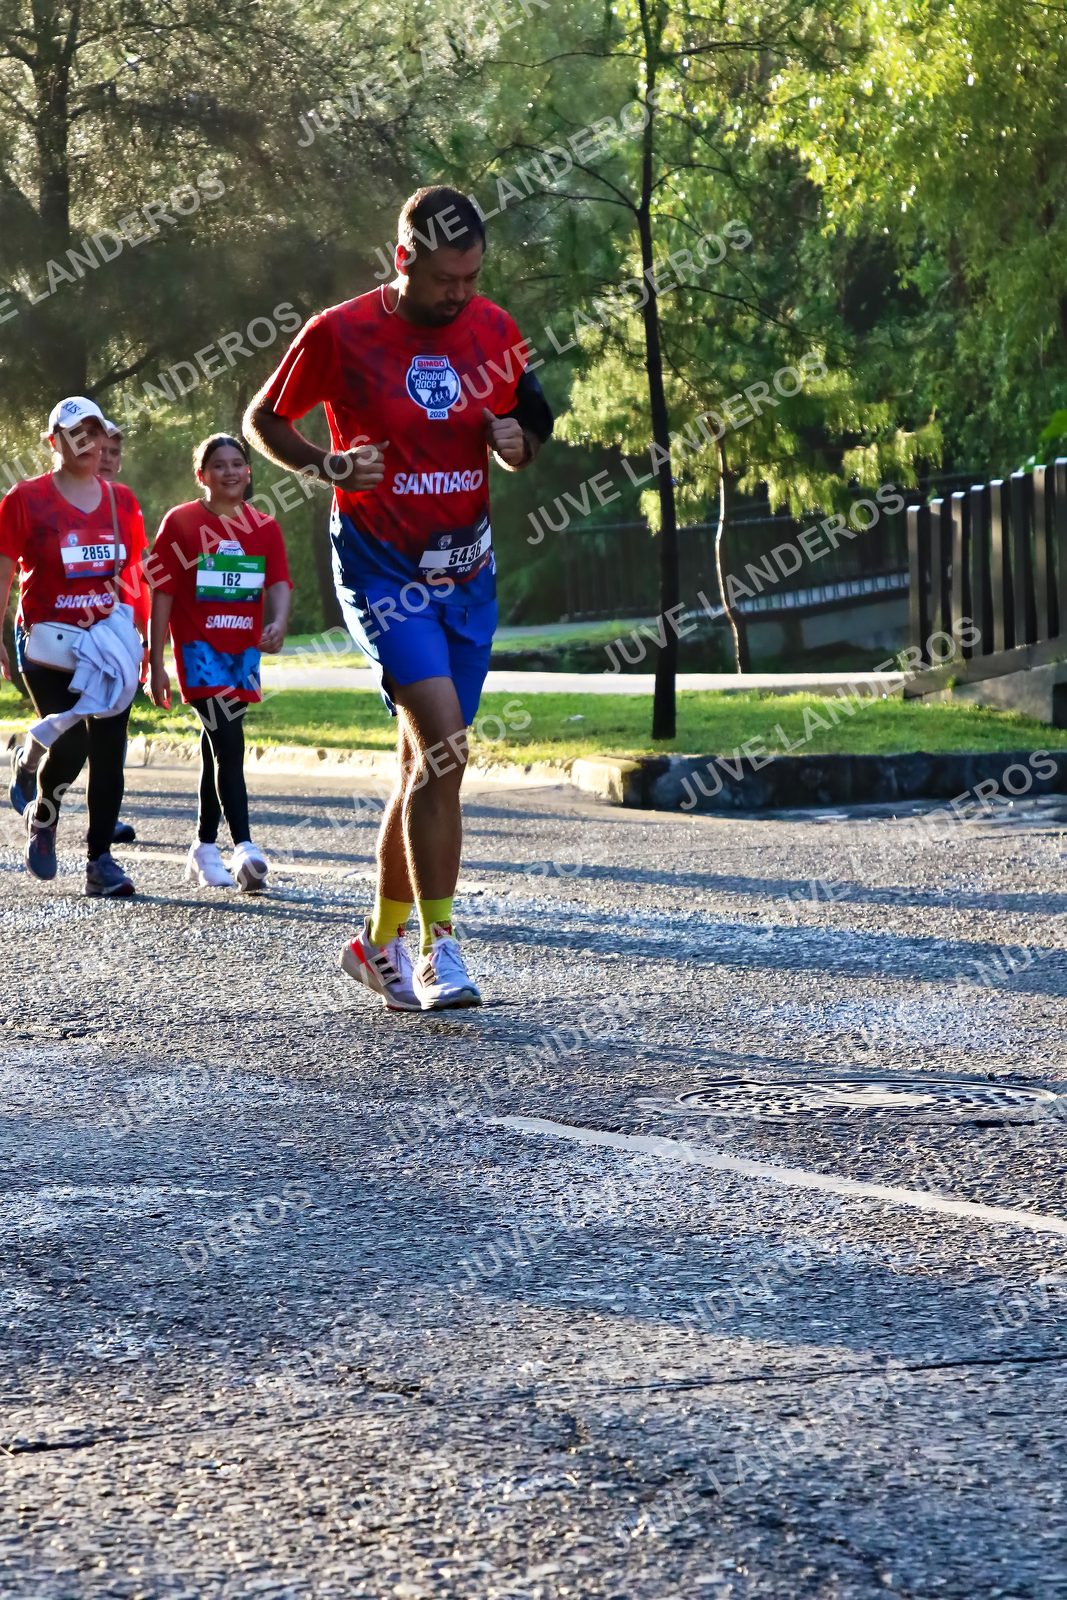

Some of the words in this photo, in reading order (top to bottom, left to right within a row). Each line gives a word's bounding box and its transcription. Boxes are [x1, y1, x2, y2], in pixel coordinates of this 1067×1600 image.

[419, 370, 446, 381] Global
[414, 379, 437, 389] Race
[429, 410, 447, 418] 2026
[391, 469, 484, 495] SANTIAGO
[82, 546, 111, 560] 2855
[448, 539, 482, 566] 5436
[222, 572, 241, 587] 162
[54, 591, 114, 609] SANTIAGO
